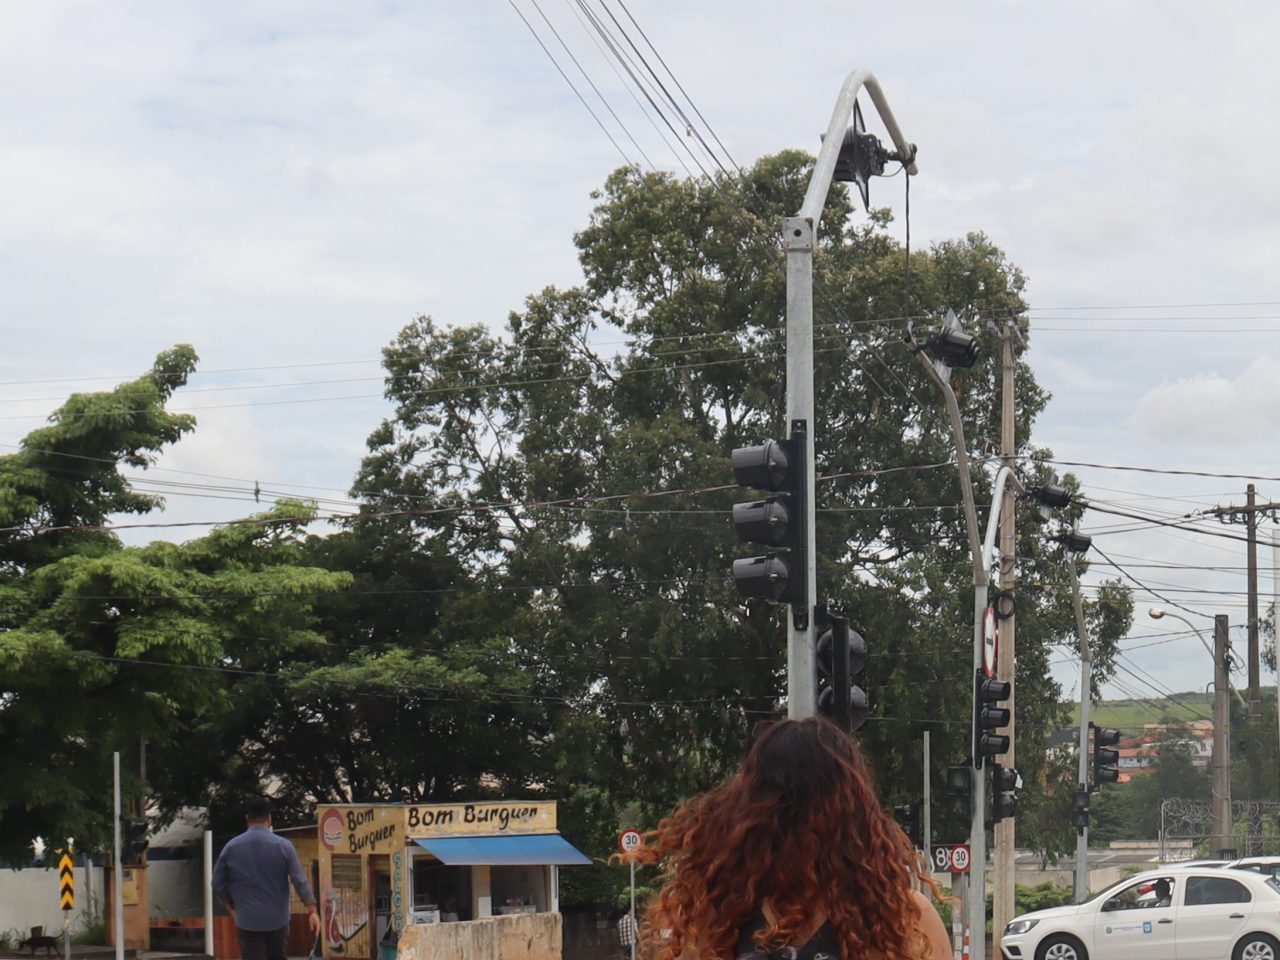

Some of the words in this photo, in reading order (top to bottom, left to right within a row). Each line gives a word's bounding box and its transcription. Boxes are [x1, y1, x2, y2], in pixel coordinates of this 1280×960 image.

[347, 808, 374, 832] Bom
[407, 806, 453, 828] Bom
[464, 804, 538, 830] Burguer
[349, 823, 395, 853] Burguer
[625, 834, 638, 845] 30
[955, 850, 967, 861] 30
